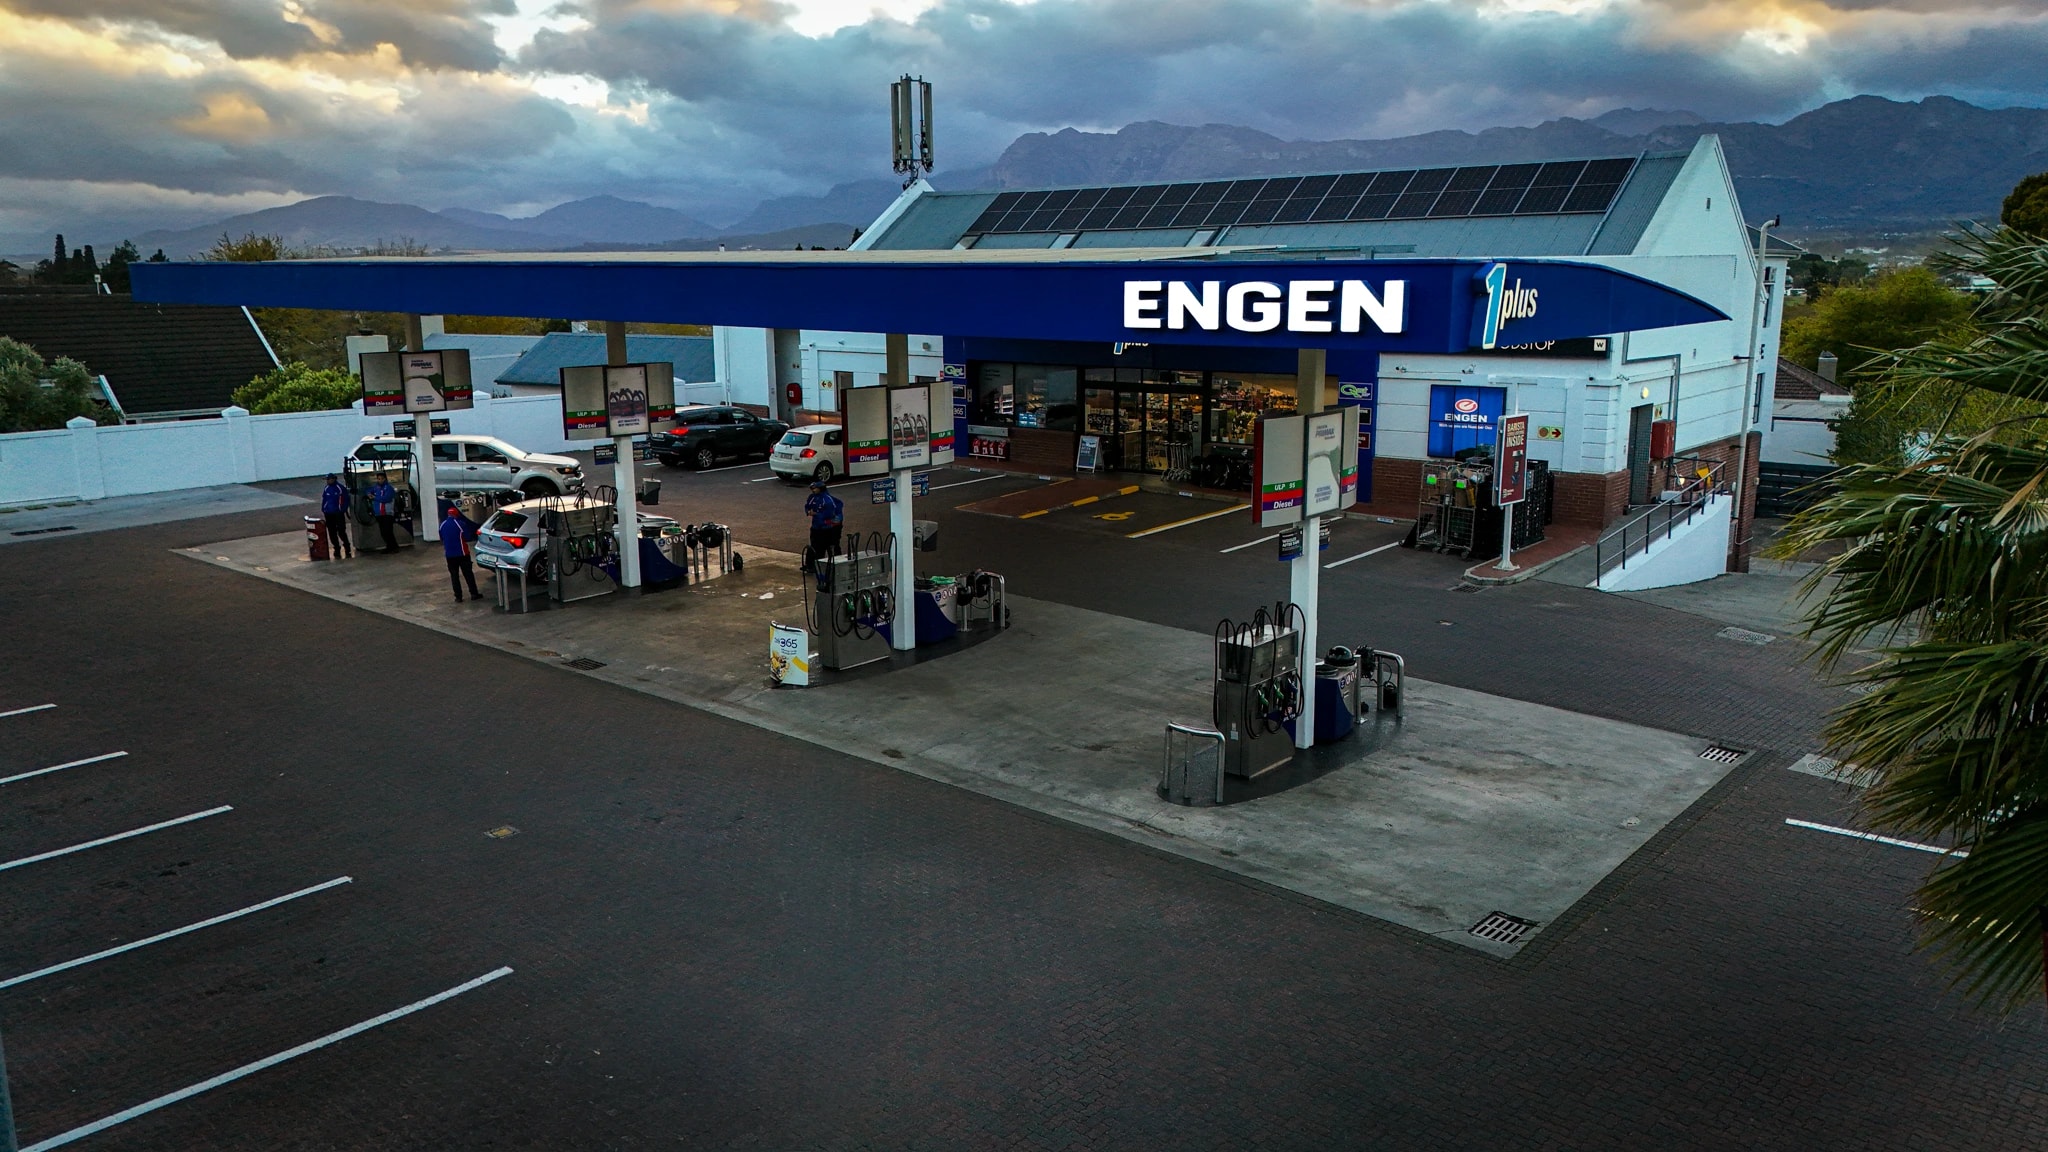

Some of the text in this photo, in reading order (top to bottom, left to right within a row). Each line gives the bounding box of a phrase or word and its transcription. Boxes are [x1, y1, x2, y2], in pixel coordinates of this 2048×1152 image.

[1124, 280, 1405, 333] ENGEN
[1444, 413, 1488, 423] ENGEN
[1506, 435, 1524, 448] INSIDE
[859, 454, 880, 462] Diesel
[1274, 483, 1286, 491] ULP
[1273, 499, 1294, 509] Diesel
[779, 637, 798, 649] 365
